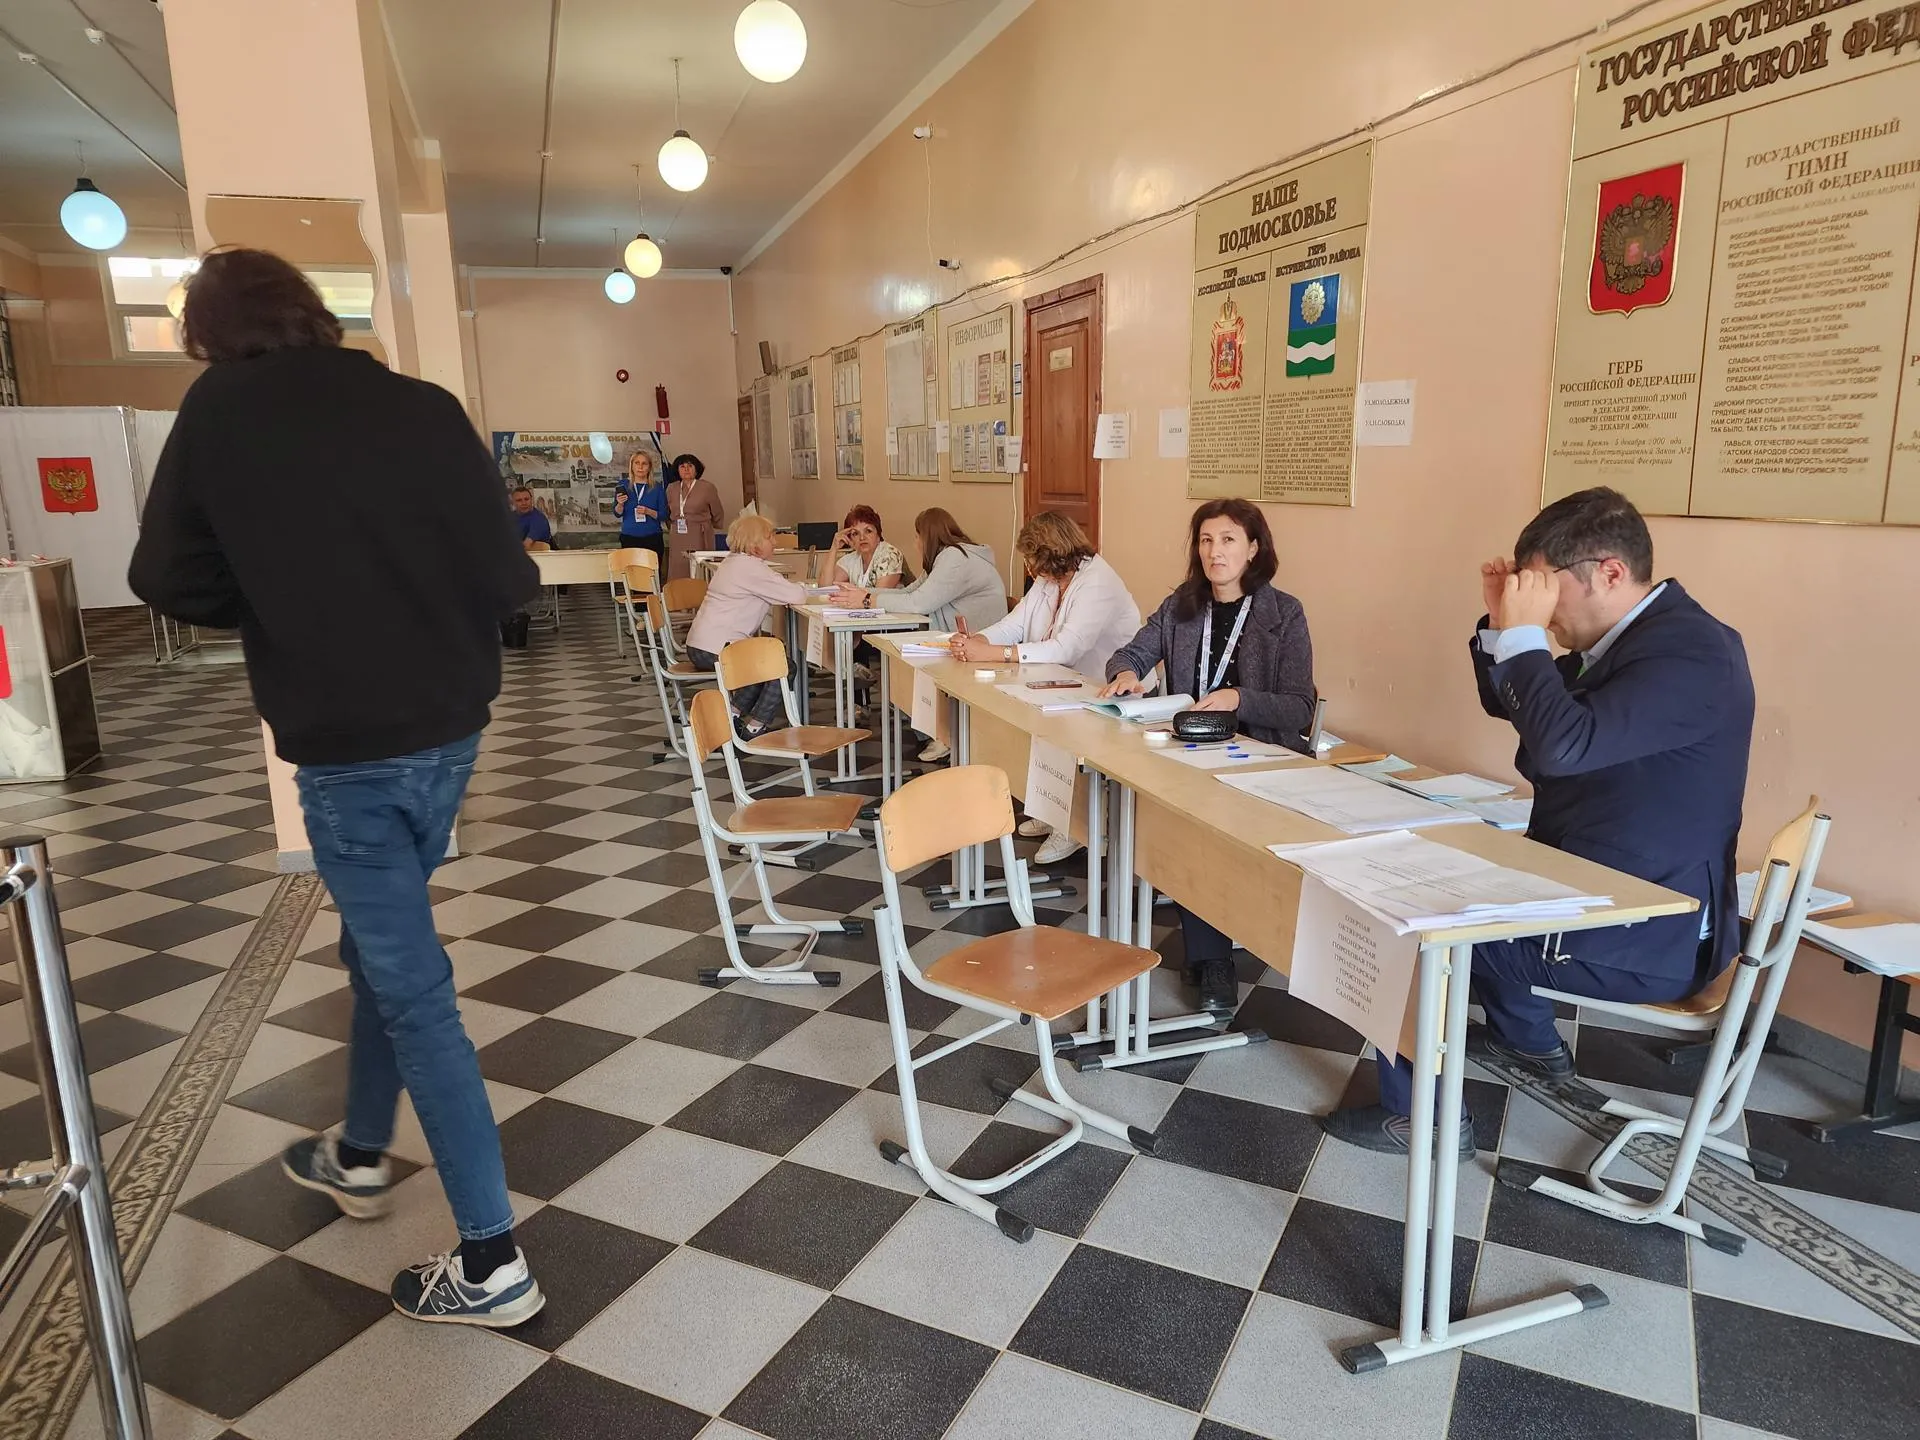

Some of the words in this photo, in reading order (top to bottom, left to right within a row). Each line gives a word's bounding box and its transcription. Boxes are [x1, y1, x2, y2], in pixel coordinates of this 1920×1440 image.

[1596, 0, 1858, 92] ГОСУДАРСТВЕ
[1620, 21, 1832, 129] РОССИЙСКОЙ
[1746, 116, 1901, 168] ГОСУДАРСТВЕННЫЙ
[1786, 150, 1849, 180] ГИМН
[1251, 180, 1299, 216] НАШЕ
[1721, 179, 1815, 213] РОССИЙСКОЙ
[1218, 197, 1337, 254] ПОДМОСКОВЬЕ
[1307, 242, 1327, 257] ГЕРБ
[1275, 255, 1328, 277] ИСТРИНСКОГО
[1328, 246, 1361, 264] РАЙОНА
[1223, 267, 1238, 279] ГЕРБ
[1237, 271, 1266, 287] ОБЛАСТИ
[955, 317, 1003, 346] ИНФОРМАЦИЯ
[1608, 360, 1644, 375] ГЕРБ
[1560, 377, 1625, 393] РОССИЙСКОЙ
[1627, 373, 1697, 388] ФЕДЕРАЦИИ
[1563, 399, 1590, 408] ПРИНЯТ
[1591, 393, 1659, 406] ГОСУДАРСТВЕННОЙ
[1660, 392, 1687, 402] ДУМОЙ
[1568, 416, 1598, 424] ОДОБРЕН
[1599, 414, 1631, 423] СОВЕТОМ
[1632, 412, 1678, 422] ФЕДЕРАЦИИ
[1599, 406, 1630, 415] ДЕКАБРЯ
[1598, 423, 1630, 432] ДЕКАБРЯ
[1710, 416, 1725, 425] НАМ
[1746, 424, 1760, 432] ТАК
[1723, 448, 1753, 456] АТСКИХ
